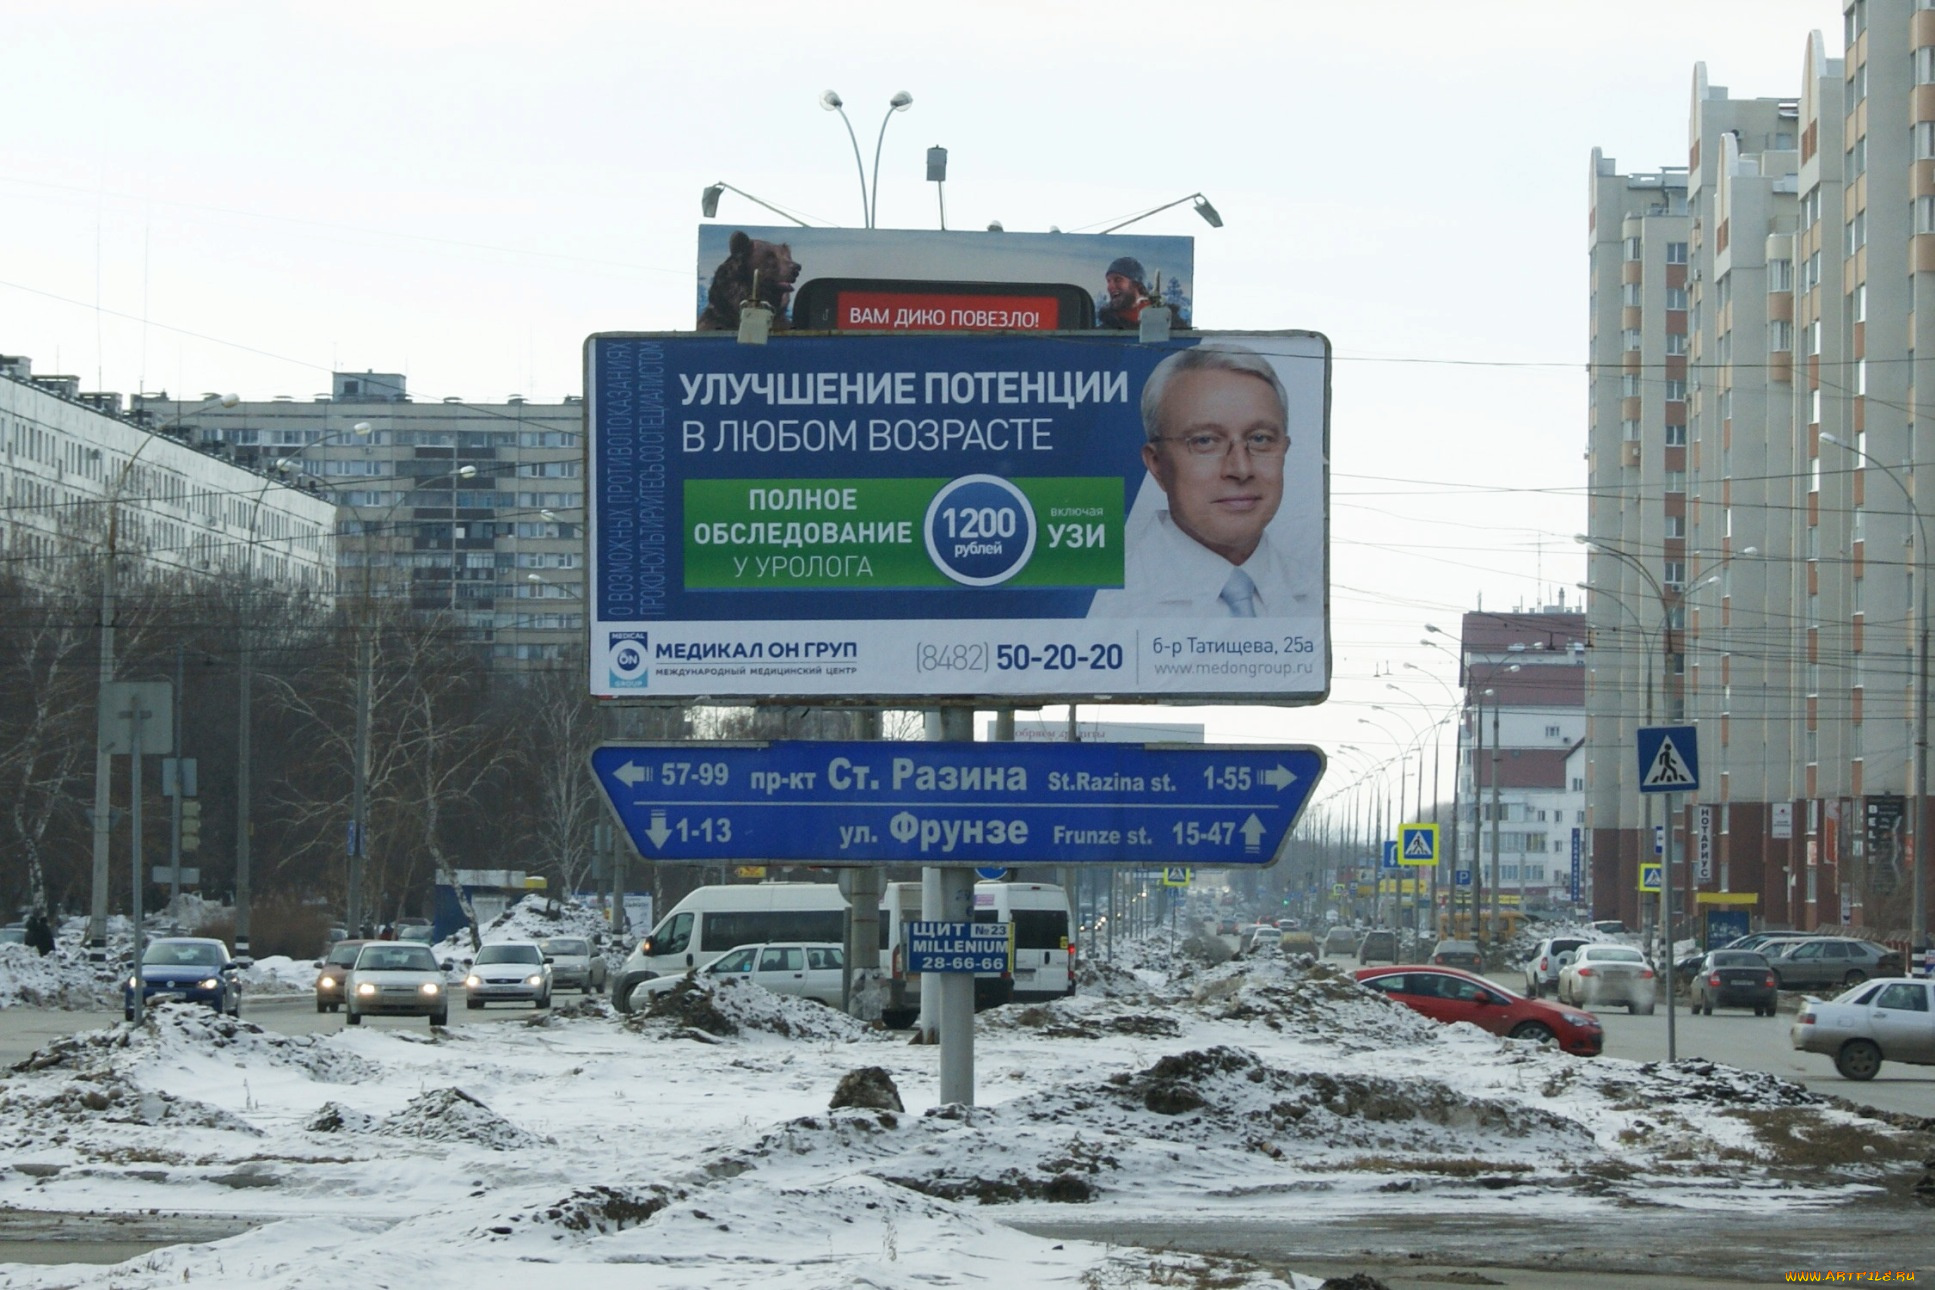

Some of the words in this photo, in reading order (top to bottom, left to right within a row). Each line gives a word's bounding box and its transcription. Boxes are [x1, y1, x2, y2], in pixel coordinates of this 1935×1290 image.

[850, 307, 889, 324] ВАМ
[894, 309, 945, 328] ДИКО
[951, 309, 1039, 328] ПОВЕЗЛО!
[679, 372, 917, 406] УЛУЧШЕНИЕ
[925, 371, 1128, 409] ПОТЕНЦИИ
[606, 342, 633, 504] ПРОТИВОПОКАЗАНИЯХ
[682, 420, 705, 452] В
[713, 419, 857, 452] ЛЮБОМ
[869, 418, 1053, 451] ВОЗРАСТЕ
[749, 488, 858, 511] ПОЛНОЕ
[942, 507, 1016, 539] 1200
[1050, 506, 1104, 517] включая
[694, 522, 913, 548] ОБСЛЕДОВАНИЕ
[1048, 523, 1106, 549] УЗИ
[607, 508, 634, 602] ВОЗМОЖНЫХ
[954, 540, 1003, 558] рублей
[733, 556, 749, 578] У
[755, 556, 874, 578] УРОЛОГА
[611, 632, 645, 641] MEDICAL
[1153, 636, 1182, 658] б-р
[1187, 636, 1278, 656] Татищева,
[1283, 636, 1314, 654] 25а
[619, 654, 639, 665] ON
[656, 643, 763, 661] МЕДИКАЛ
[768, 642, 799, 658] ОН
[804, 642, 858, 658] ГРУП
[916, 641, 989, 673] (8482)
[996, 643, 1123, 671] 50-20-20
[655, 666, 746, 677] МЕЖДУНАРОДНЫЙ
[750, 665, 822, 676] МЕДИЦИНСКИЙ
[826, 667, 858, 677] ЦЕНТР
[1154, 660, 1313, 678] www.medongroup.ru
[661, 762, 729, 786] 57-99
[751, 771, 816, 795] пр-кт
[828, 757, 879, 791] Ст.
[892, 758, 1027, 791] Разина
[1151, 772, 1177, 792] st.
[1203, 765, 1252, 791] 1-55
[675, 818, 732, 843] 1-13
[840, 826, 877, 849] ул.
[890, 811, 1029, 852] Фрунзе
[1054, 825, 1121, 845] Frunze
[1128, 826, 1152, 845] st.
[1172, 821, 1236, 846] 15-47
[1701, 808, 1710, 877] НОТАРИУС
[913, 922, 965, 938] ЩИТ
[913, 940, 1009, 953] MILLENIUM
[922, 956, 1004, 970] 28-66-66
